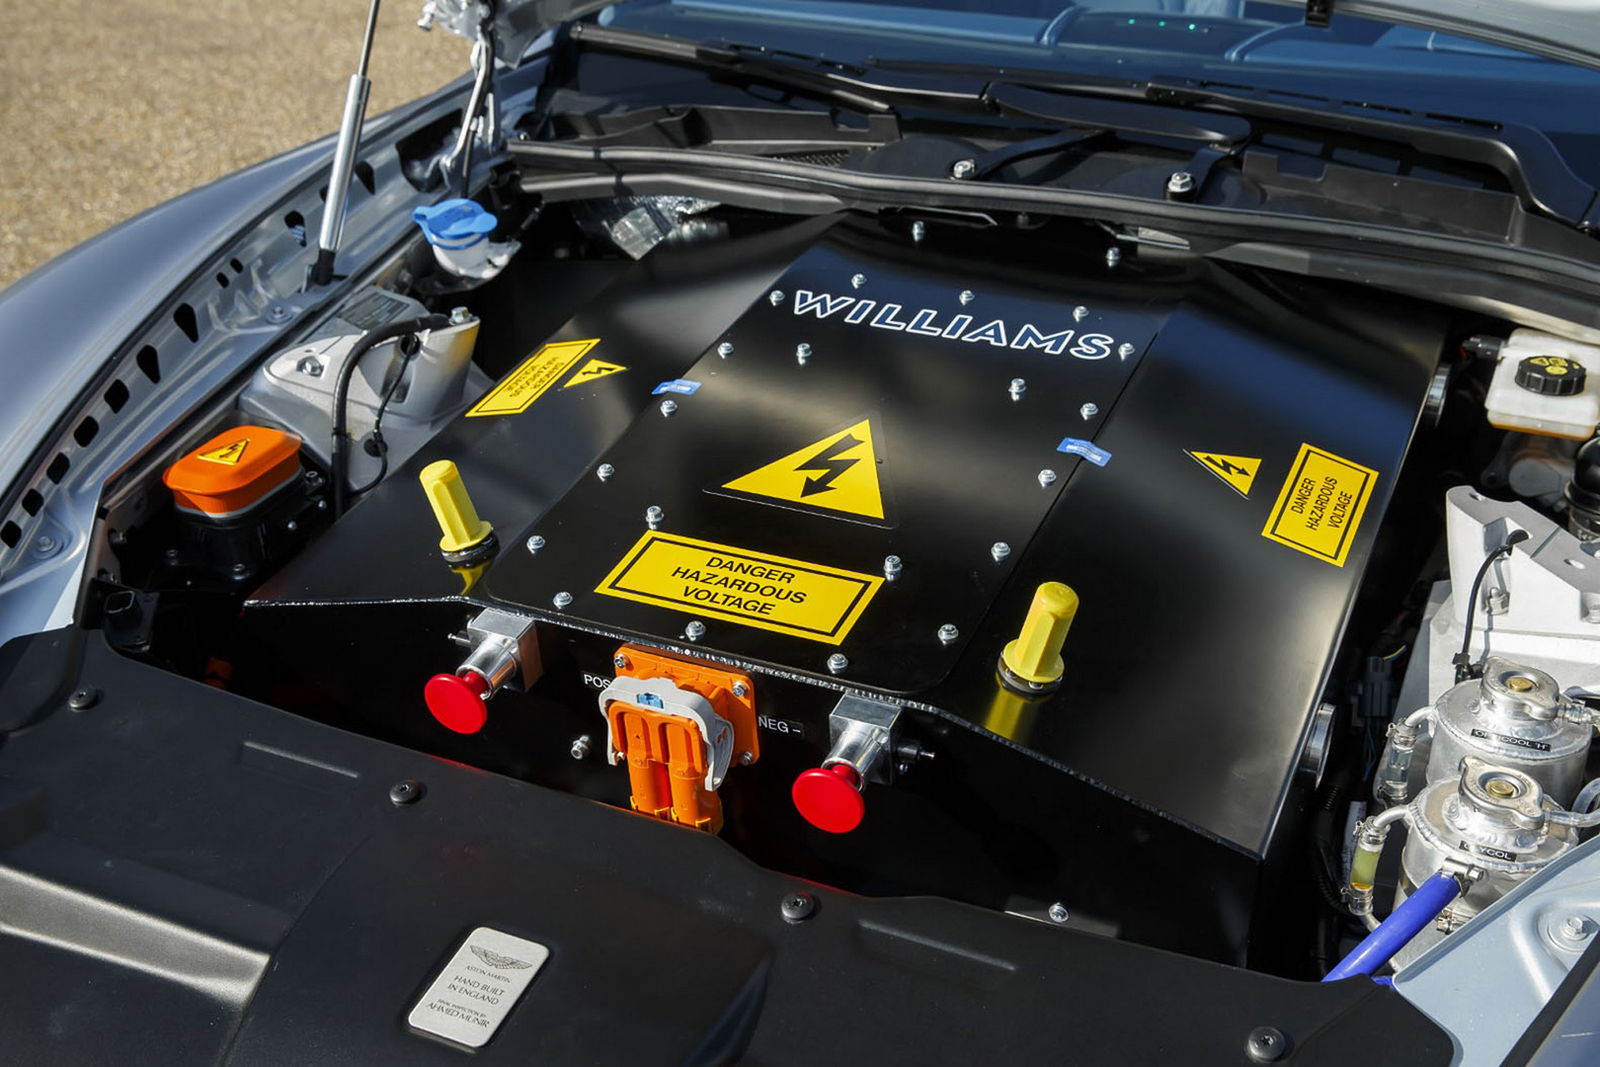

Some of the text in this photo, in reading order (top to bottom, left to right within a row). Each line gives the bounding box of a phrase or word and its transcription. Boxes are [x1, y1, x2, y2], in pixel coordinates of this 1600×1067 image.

[794, 290, 1114, 360] WILLIAMS
[1291, 477, 1316, 514] DANGER
[1305, 476, 1338, 531] HAZARDOUS
[1327, 490, 1353, 529] VOLTAGE
[706, 556, 796, 584] DANGER
[671, 566, 807, 604] HAZARDOUS
[683, 586, 776, 615] VOLTAGE
[583, 673, 611, 689] POS
[758, 715, 789, 734] NEG
[454, 975, 505, 996] HAND BUILT
[465, 965, 487, 976] ASTON
[487, 971, 511, 983] MARTIN
[448, 983, 499, 1005] IN ENGLAND
[427, 1002, 460, 1017] AHMED
